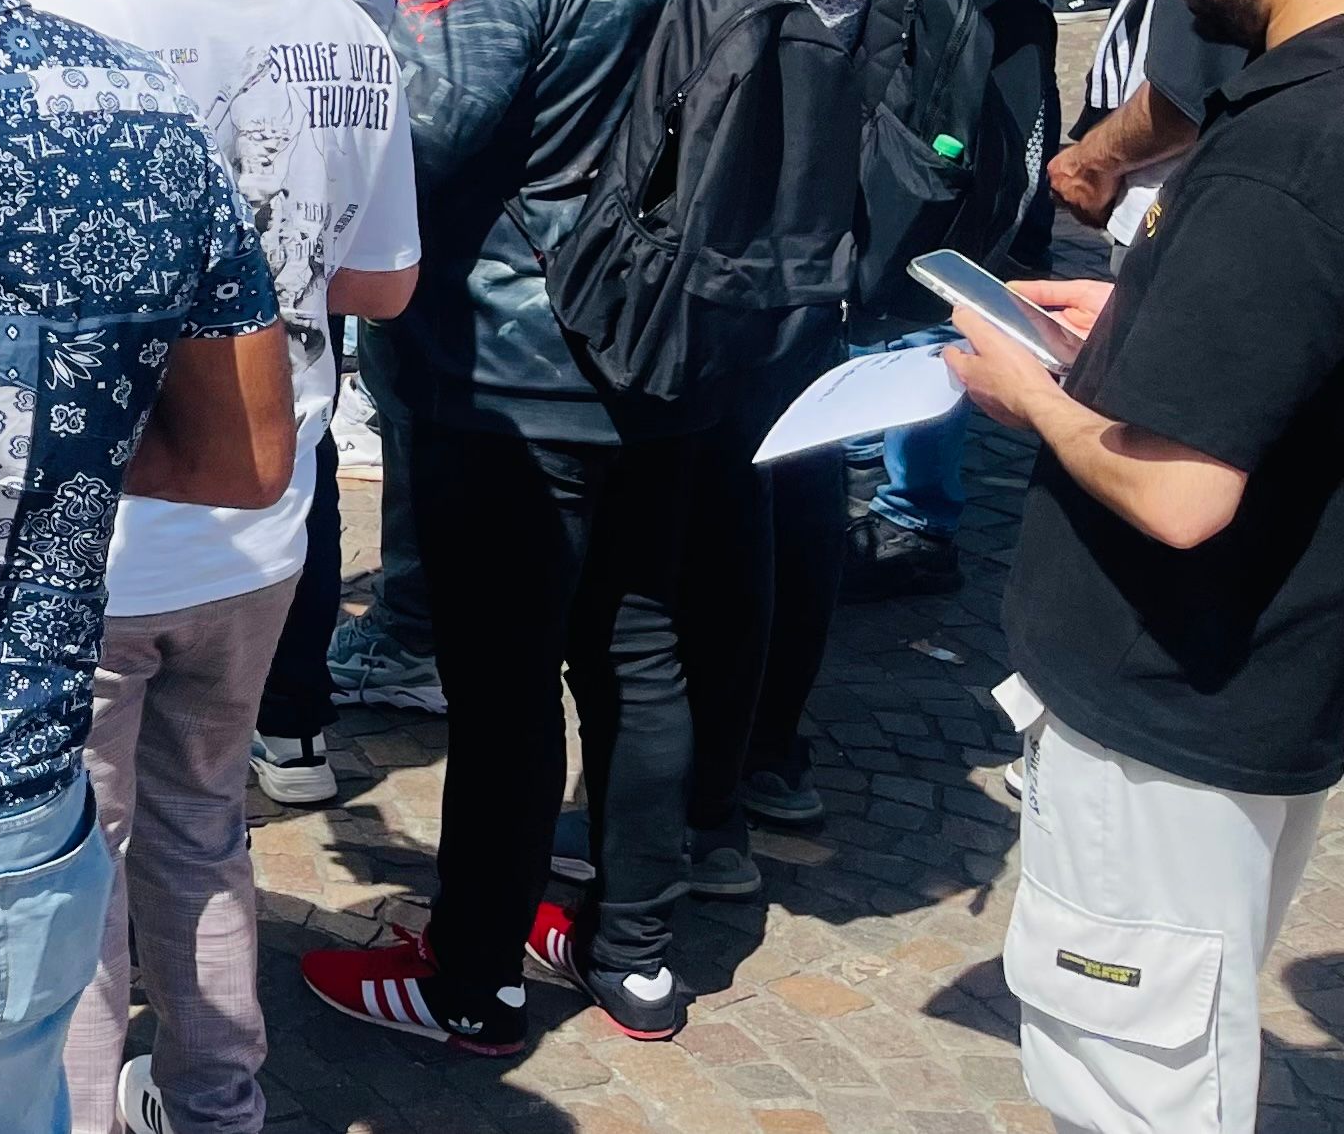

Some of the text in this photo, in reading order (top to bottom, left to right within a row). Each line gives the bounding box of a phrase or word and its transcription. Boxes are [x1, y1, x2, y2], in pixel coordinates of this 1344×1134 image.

[269, 42, 392, 85] STRIKE WITH
[305, 85, 390, 131] THUNDER
